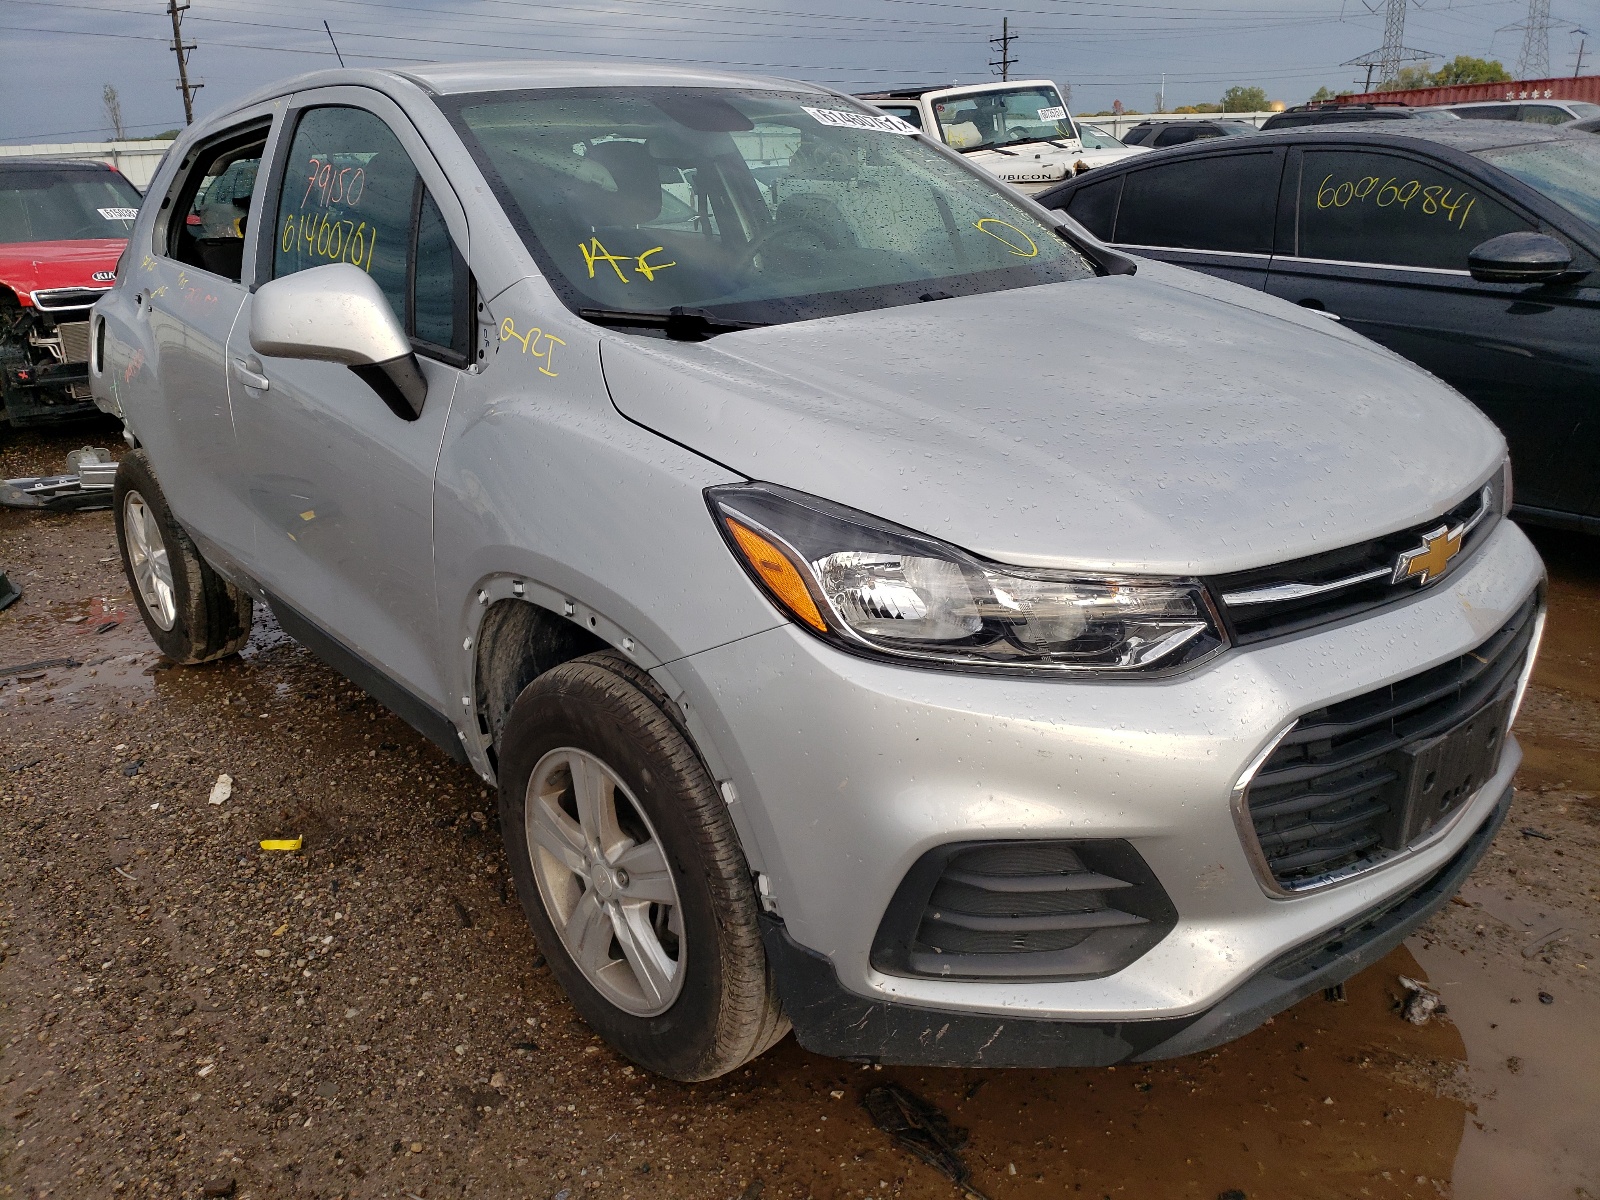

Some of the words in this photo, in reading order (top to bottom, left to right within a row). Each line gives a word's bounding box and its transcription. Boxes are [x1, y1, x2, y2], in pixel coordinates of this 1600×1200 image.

[300, 159, 365, 209] 79150
[1317, 174, 1476, 230] 60969841
[282, 212, 376, 274] 61460761
[96, 271, 116, 280] KIA
